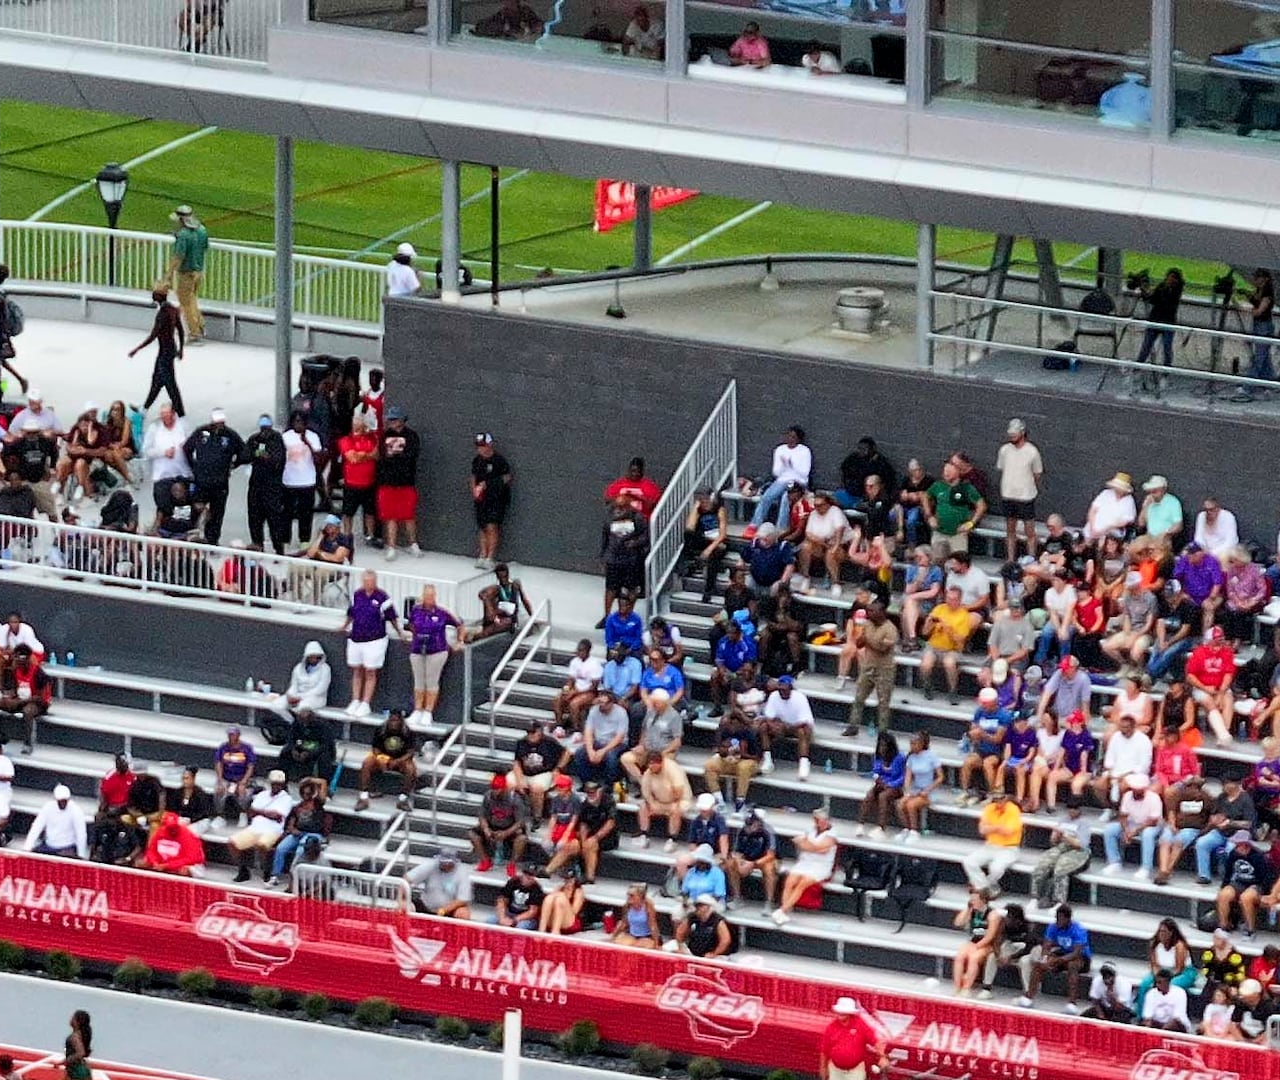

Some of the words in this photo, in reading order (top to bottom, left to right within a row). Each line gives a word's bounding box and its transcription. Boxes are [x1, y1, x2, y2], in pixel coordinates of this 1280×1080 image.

[62, 913, 110, 933] CLUB
[200, 914, 299, 948] GHSA
[449, 945, 569, 991] ATLANTA
[449, 974, 510, 997] TRACK
[520, 986, 569, 1006] CLUB
[660, 986, 762, 1022] GHSA
[918, 1021, 1041, 1066] ATLANTA
[917, 1049, 979, 1071] TRACK
[991, 1061, 1040, 1080] CLUB
